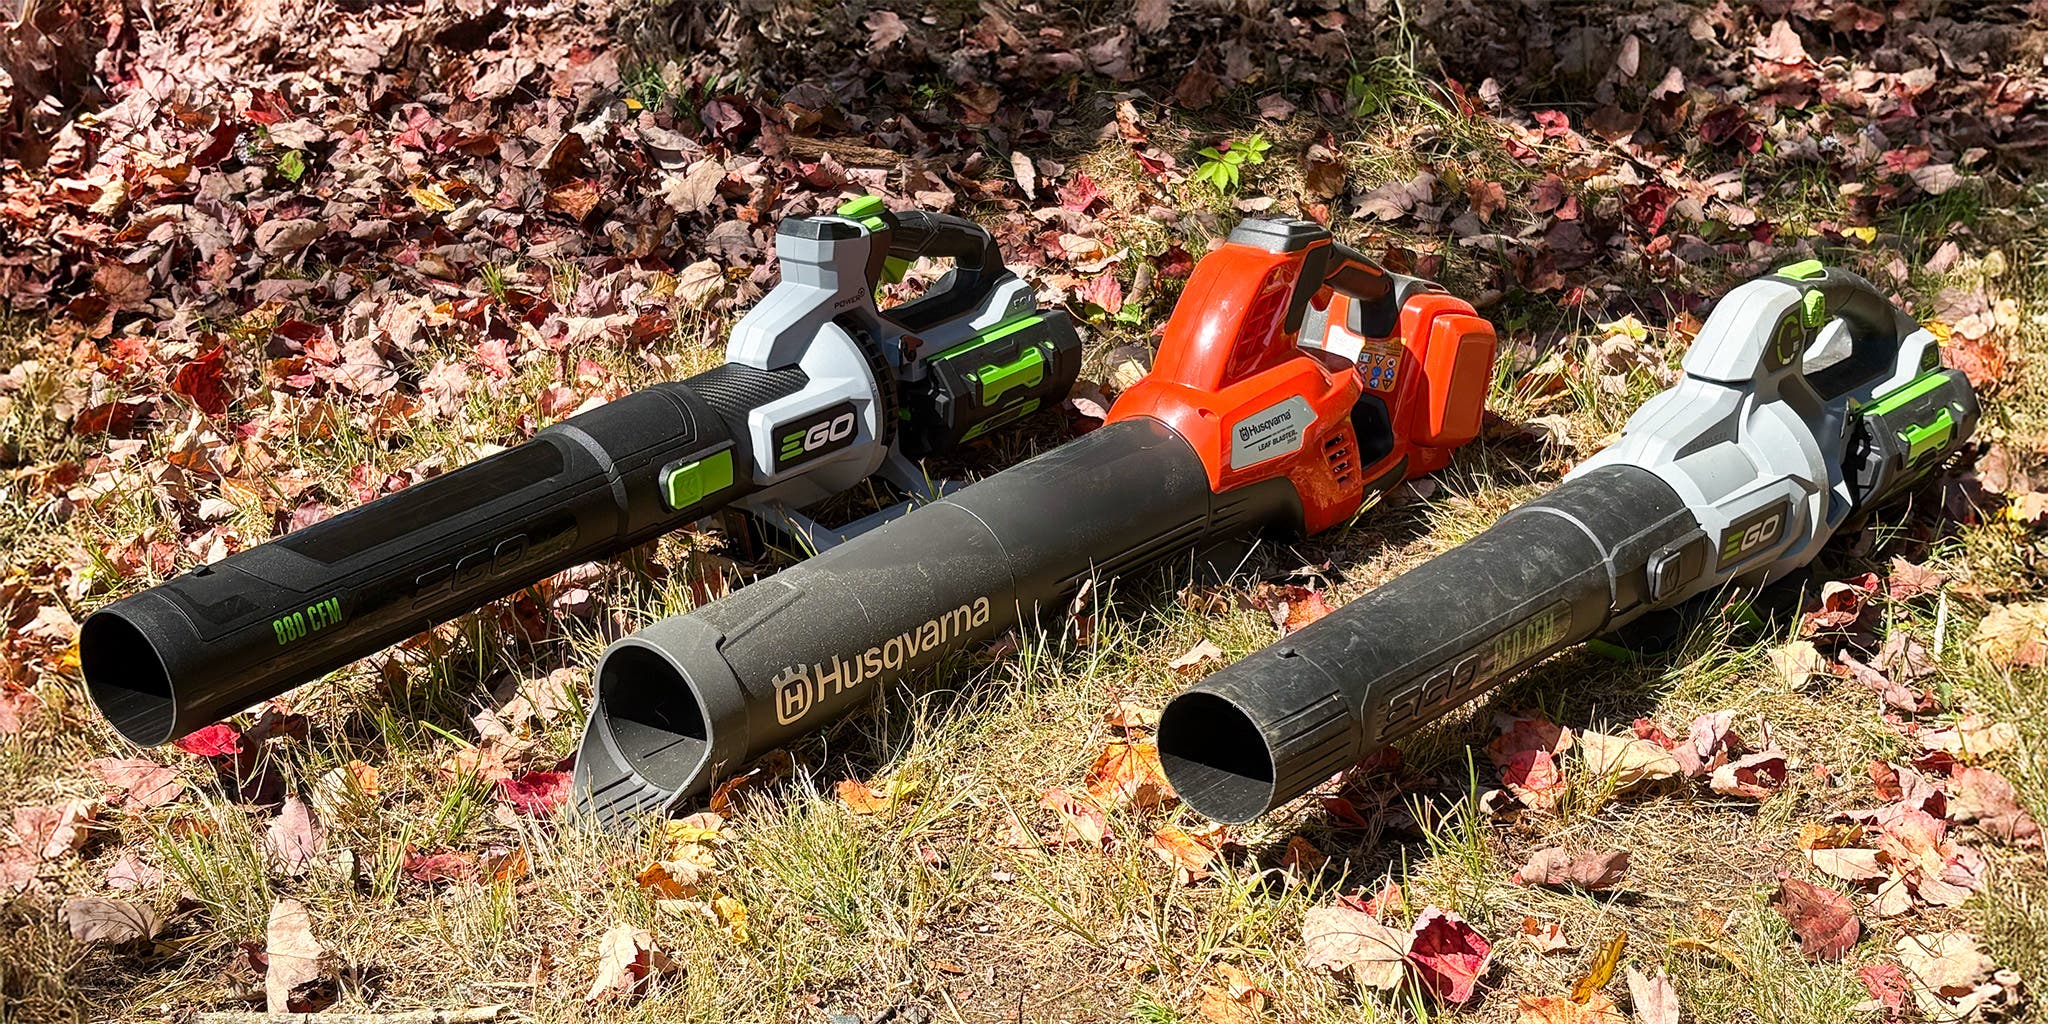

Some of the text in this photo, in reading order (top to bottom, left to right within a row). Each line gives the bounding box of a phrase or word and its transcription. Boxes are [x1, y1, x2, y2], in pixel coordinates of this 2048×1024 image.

[779, 412, 855, 462] EGO
[1248, 410, 1292, 437] Husqvarna
[1258, 440, 1272, 452] LEAF
[1722, 514, 1780, 560] EGO
[272, 597, 343, 646] 880 CFM
[814, 596, 990, 702] Husqvarna
